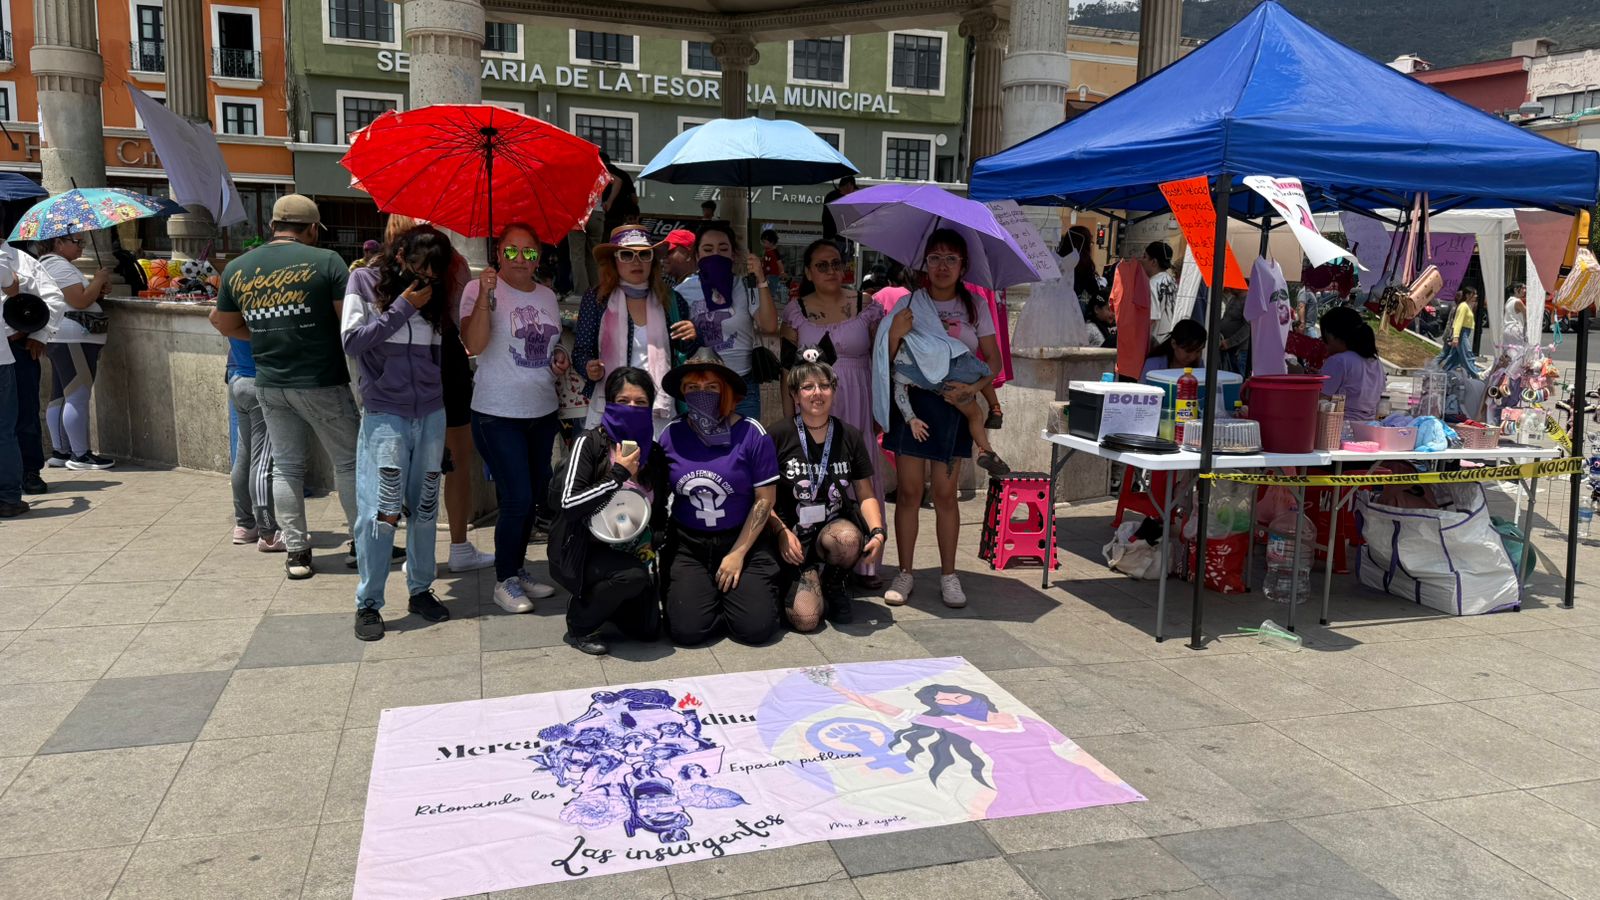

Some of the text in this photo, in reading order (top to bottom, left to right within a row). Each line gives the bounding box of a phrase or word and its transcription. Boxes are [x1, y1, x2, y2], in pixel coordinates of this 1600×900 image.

[377, 50, 899, 114] SEARIA DE LA TESORIA MUNICIPAL
[772, 185, 825, 204] FARMACI
[1108, 393, 1159, 405] BOLIS
[1538, 458, 1582, 474] AUCIÓN
[414, 793, 524, 816] Retomando
[531, 790, 555, 801] los
[800, 752, 862, 768] publicos
[829, 815, 907, 830] Mes de agosto
[551, 813, 785, 876] Las insurgentas
